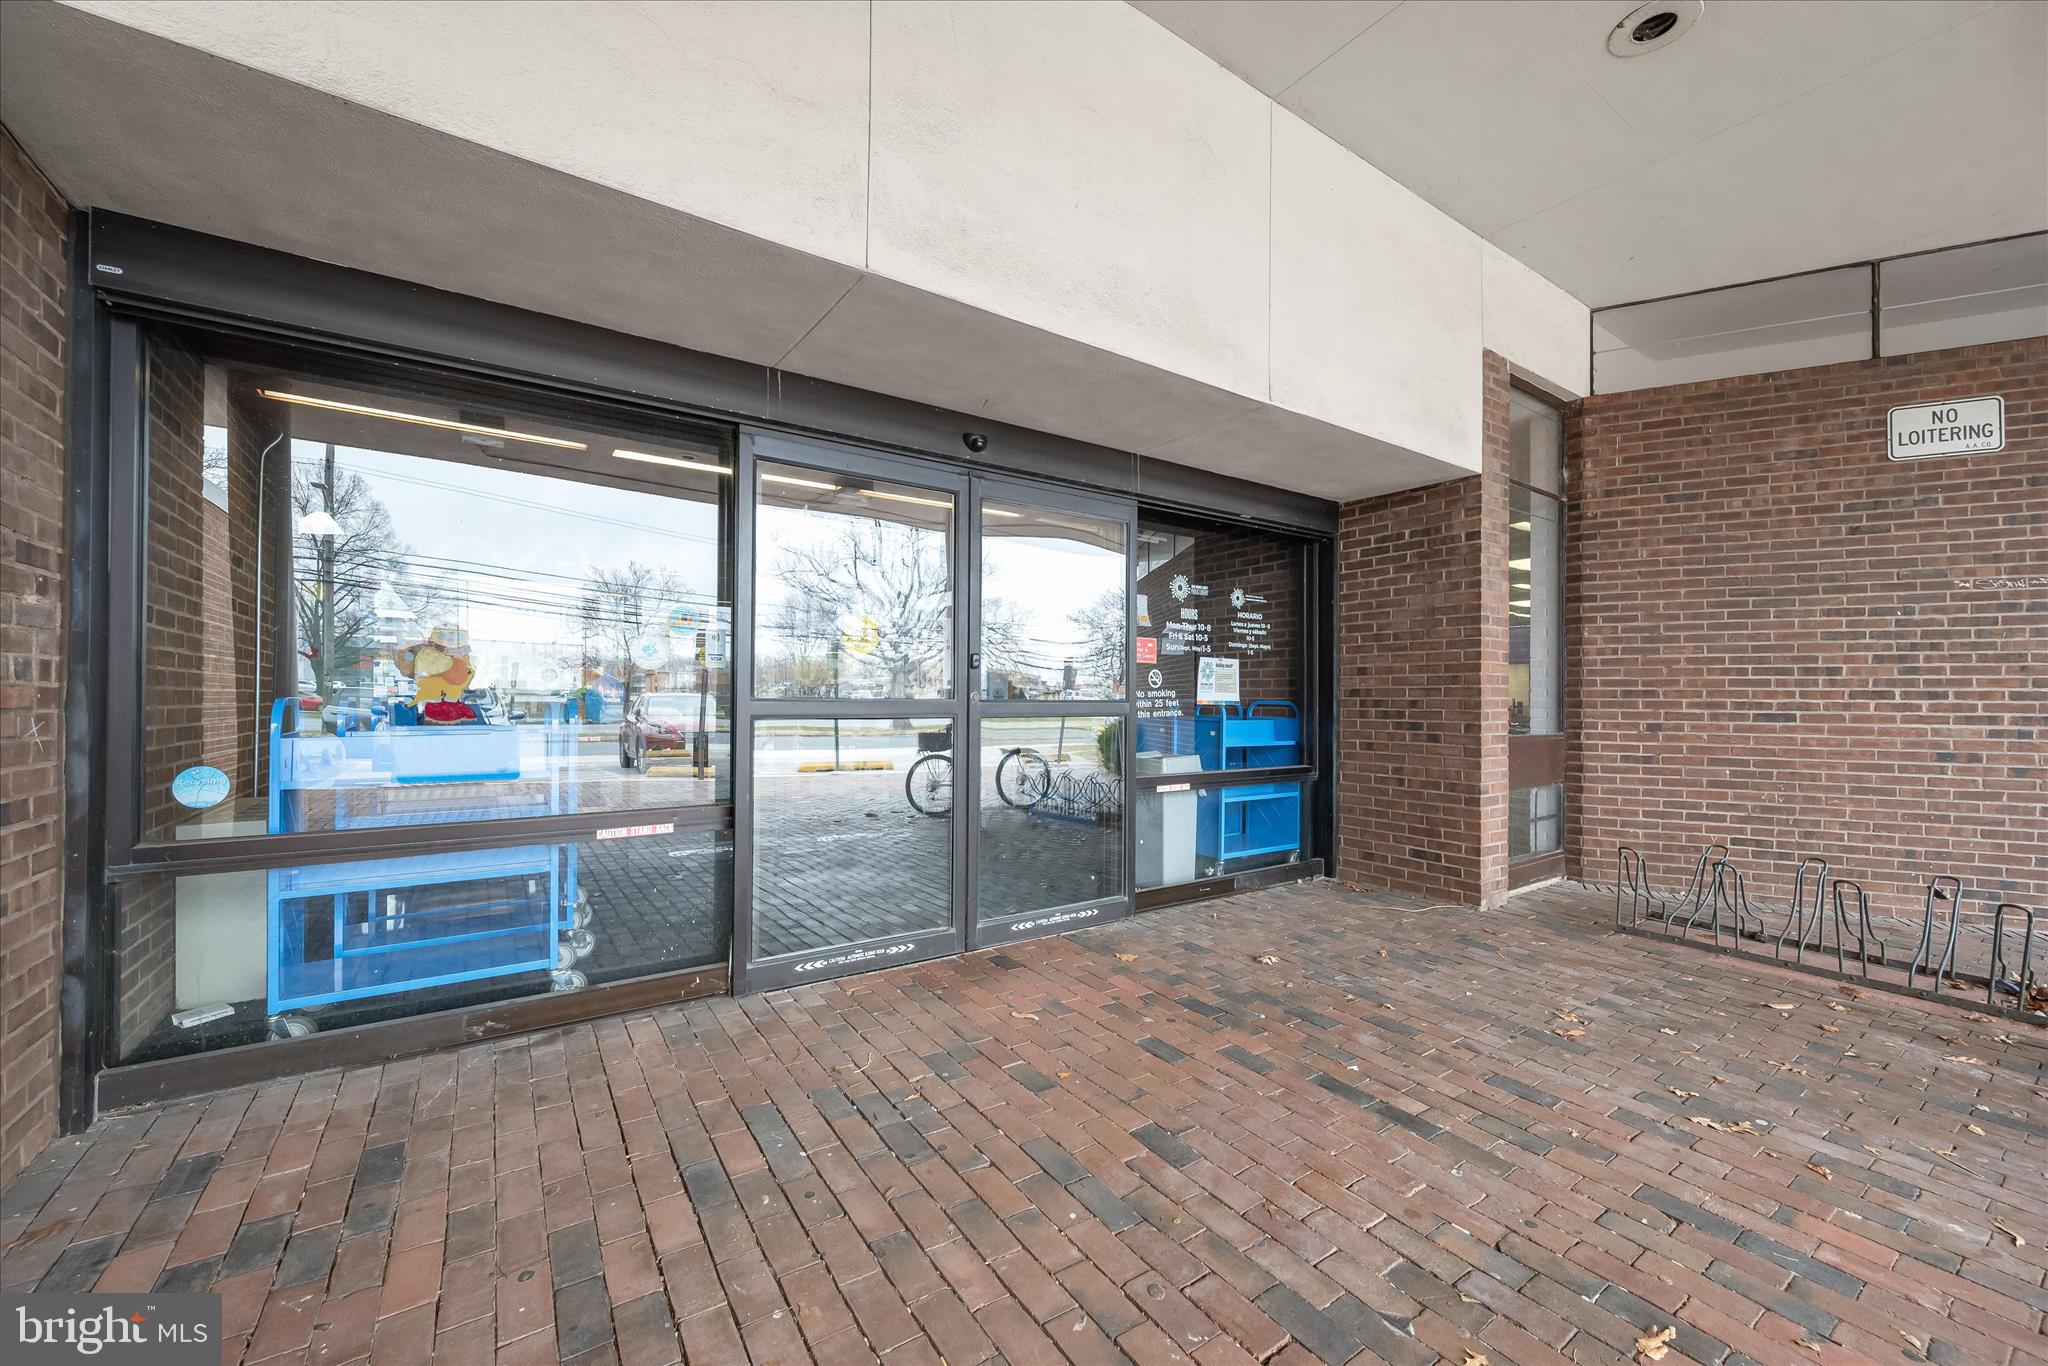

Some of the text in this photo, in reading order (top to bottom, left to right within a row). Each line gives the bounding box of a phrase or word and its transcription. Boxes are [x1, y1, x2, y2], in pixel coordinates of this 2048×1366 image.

[1932, 408, 1958, 425] NO
[1898, 423, 1994, 447] LOITERING
[1180, 607, 1199, 620] HOURS
[1237, 611, 1263, 620] HORARIO
[1197, 623, 1212, 632] 10-8
[1184, 633, 1195, 641] Sat
[1195, 633, 1209, 642] 10-5
[1136, 689, 1176, 699] No smoking
[1154, 699, 1164, 707] 25
[1165, 699, 1180, 707] feet
[1137, 709, 1184, 718] this entrance.
